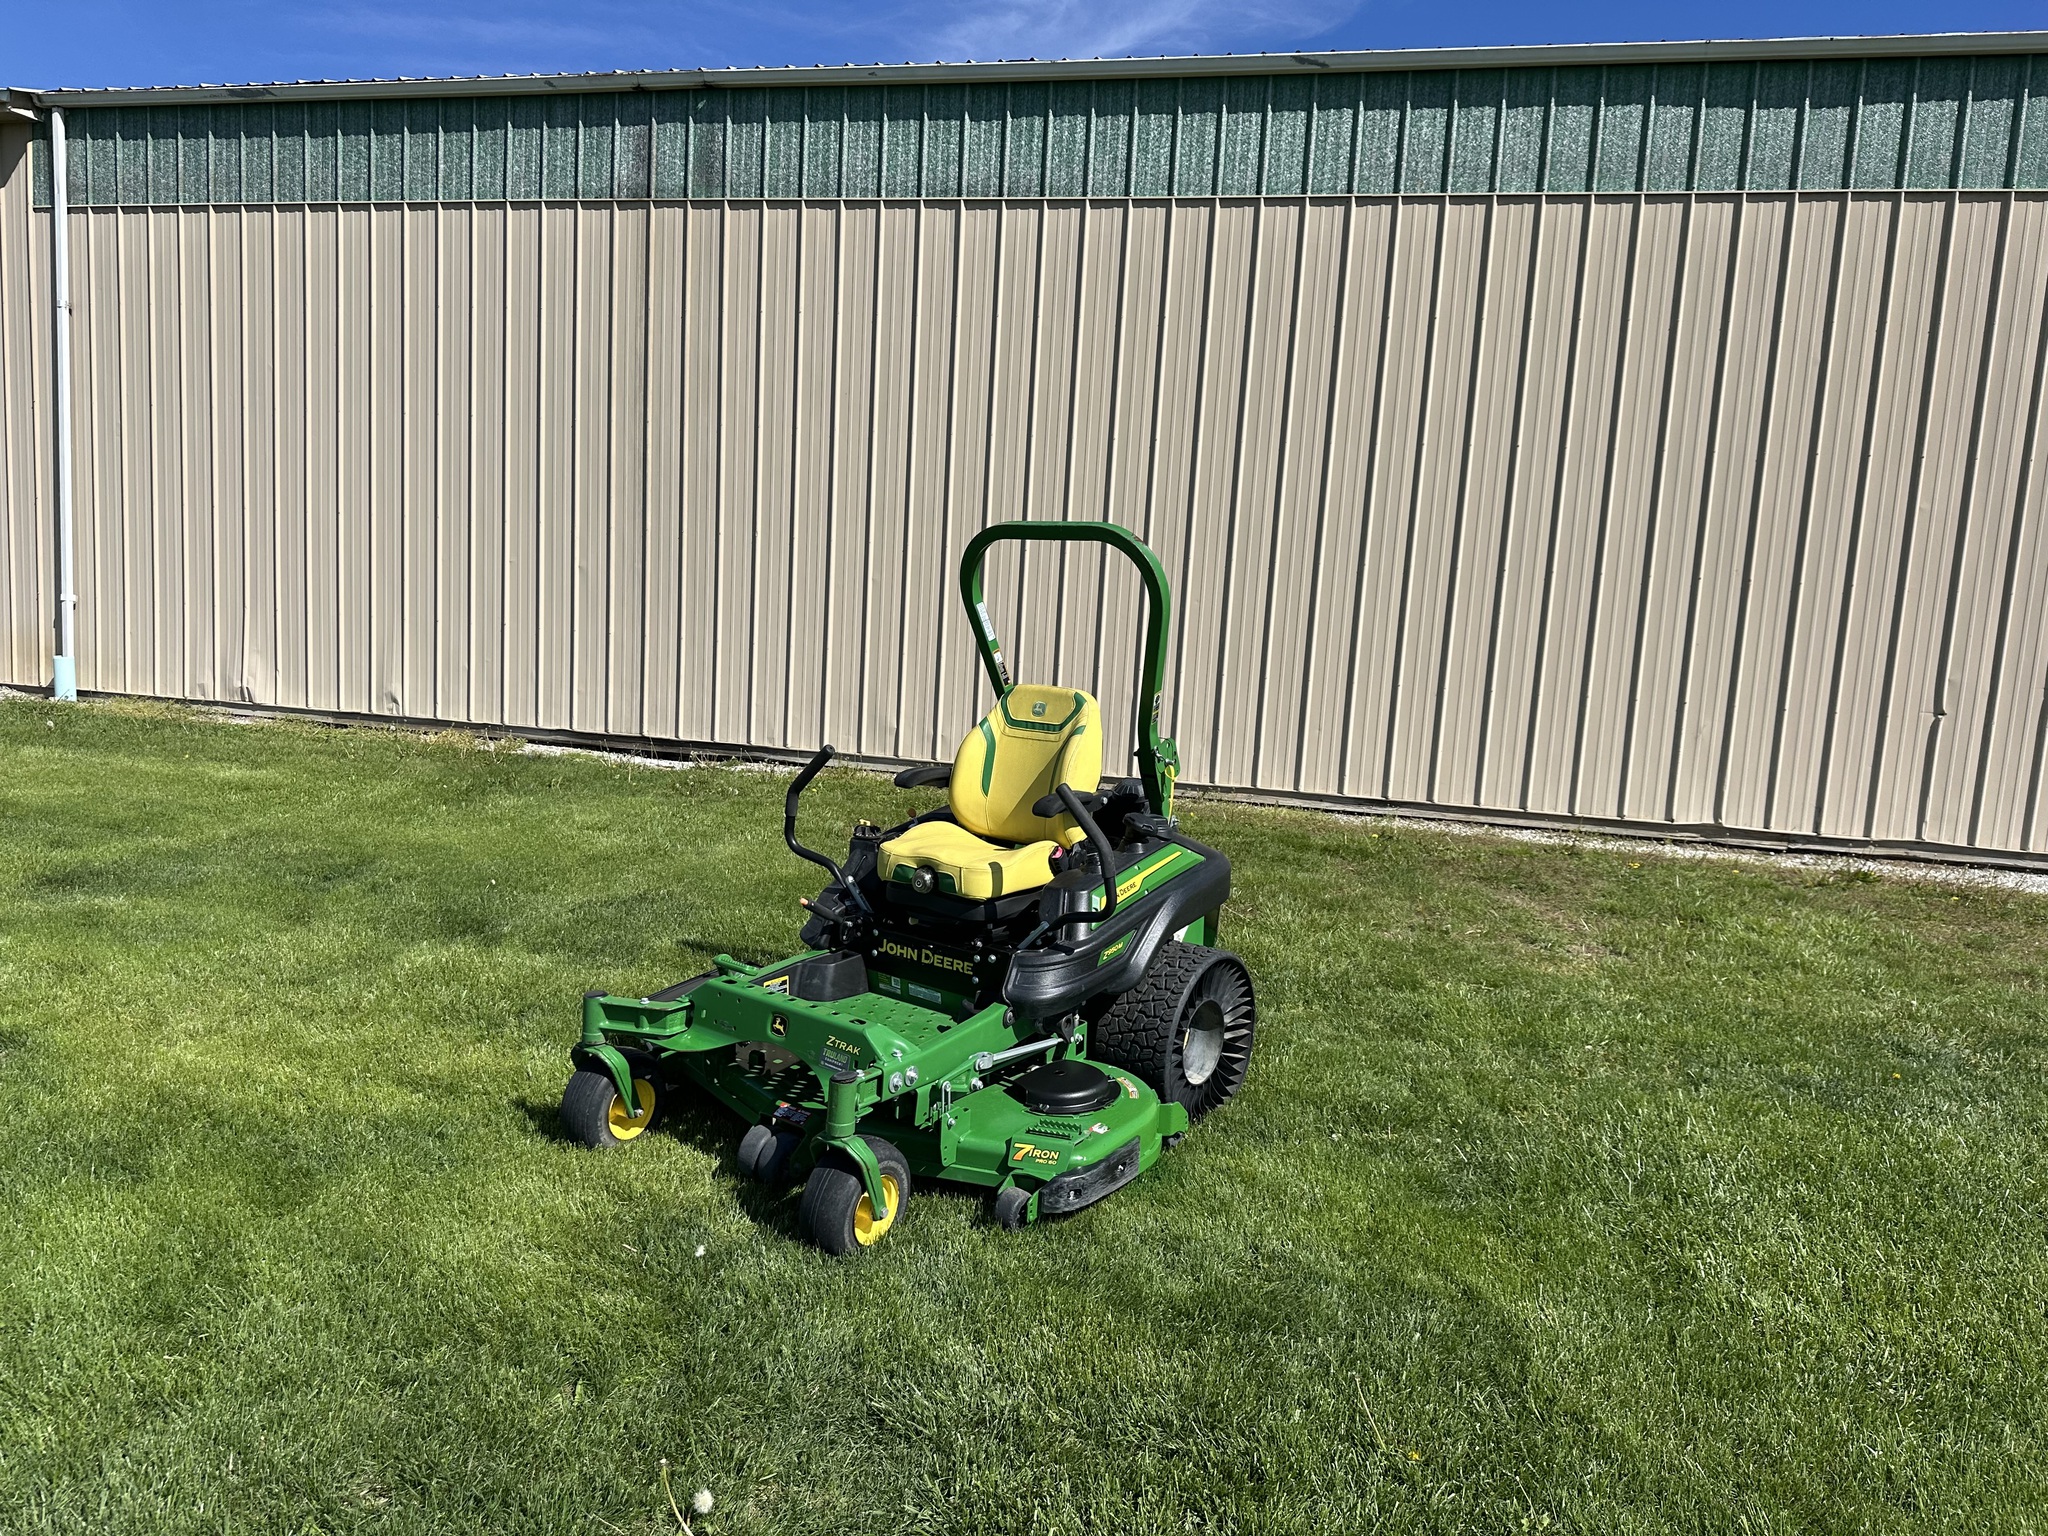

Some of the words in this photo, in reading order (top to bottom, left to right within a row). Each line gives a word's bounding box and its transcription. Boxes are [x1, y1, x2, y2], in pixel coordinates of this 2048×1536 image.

[1120, 881, 1137, 897] DEERE
[878, 938, 918, 961] JOHN
[921, 948, 974, 975] DEERE
[1102, 941, 1124, 960] Z950M
[826, 1035, 861, 1056] ZTRAK
